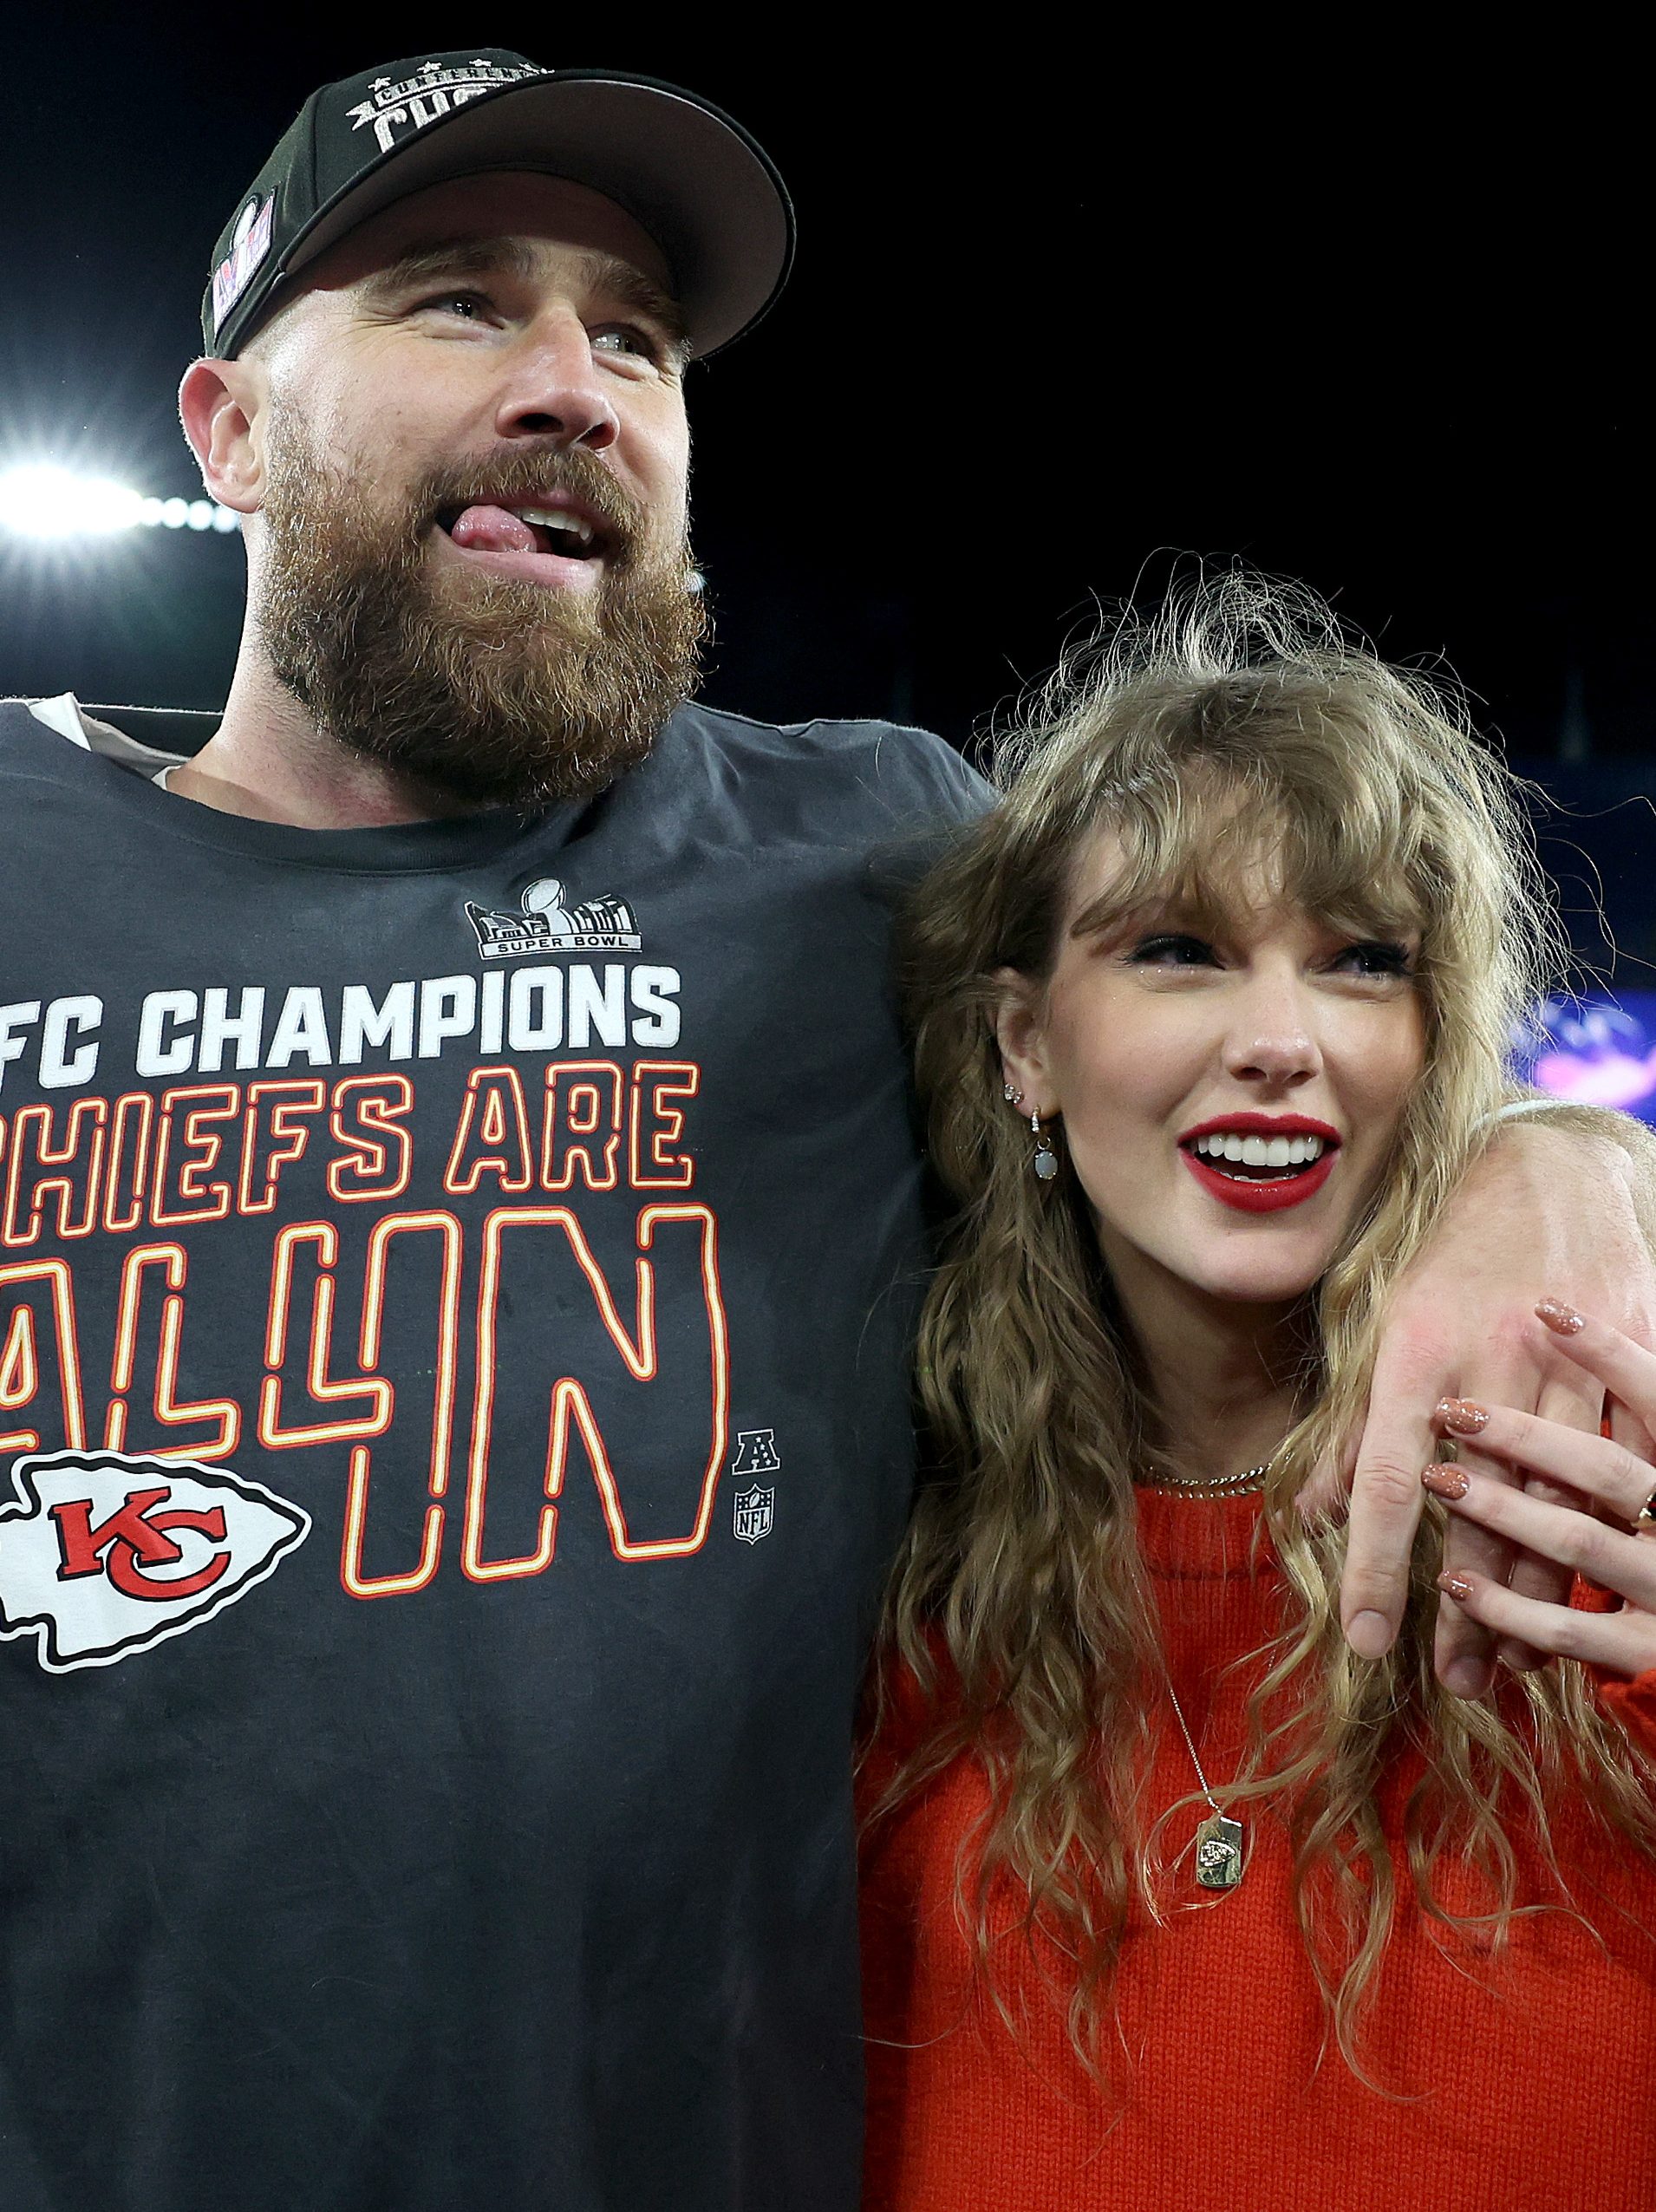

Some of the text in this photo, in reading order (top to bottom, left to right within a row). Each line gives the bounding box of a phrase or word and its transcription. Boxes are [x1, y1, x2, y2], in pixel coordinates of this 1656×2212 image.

[498, 936, 629, 953] SUPER BOWL
[136, 965, 681, 1077] CHAMPIONS
[0, 1060, 701, 1249] HIEFS ARE
[49, 1487, 231, 1602] KC
[739, 1509, 768, 1536] NFL
